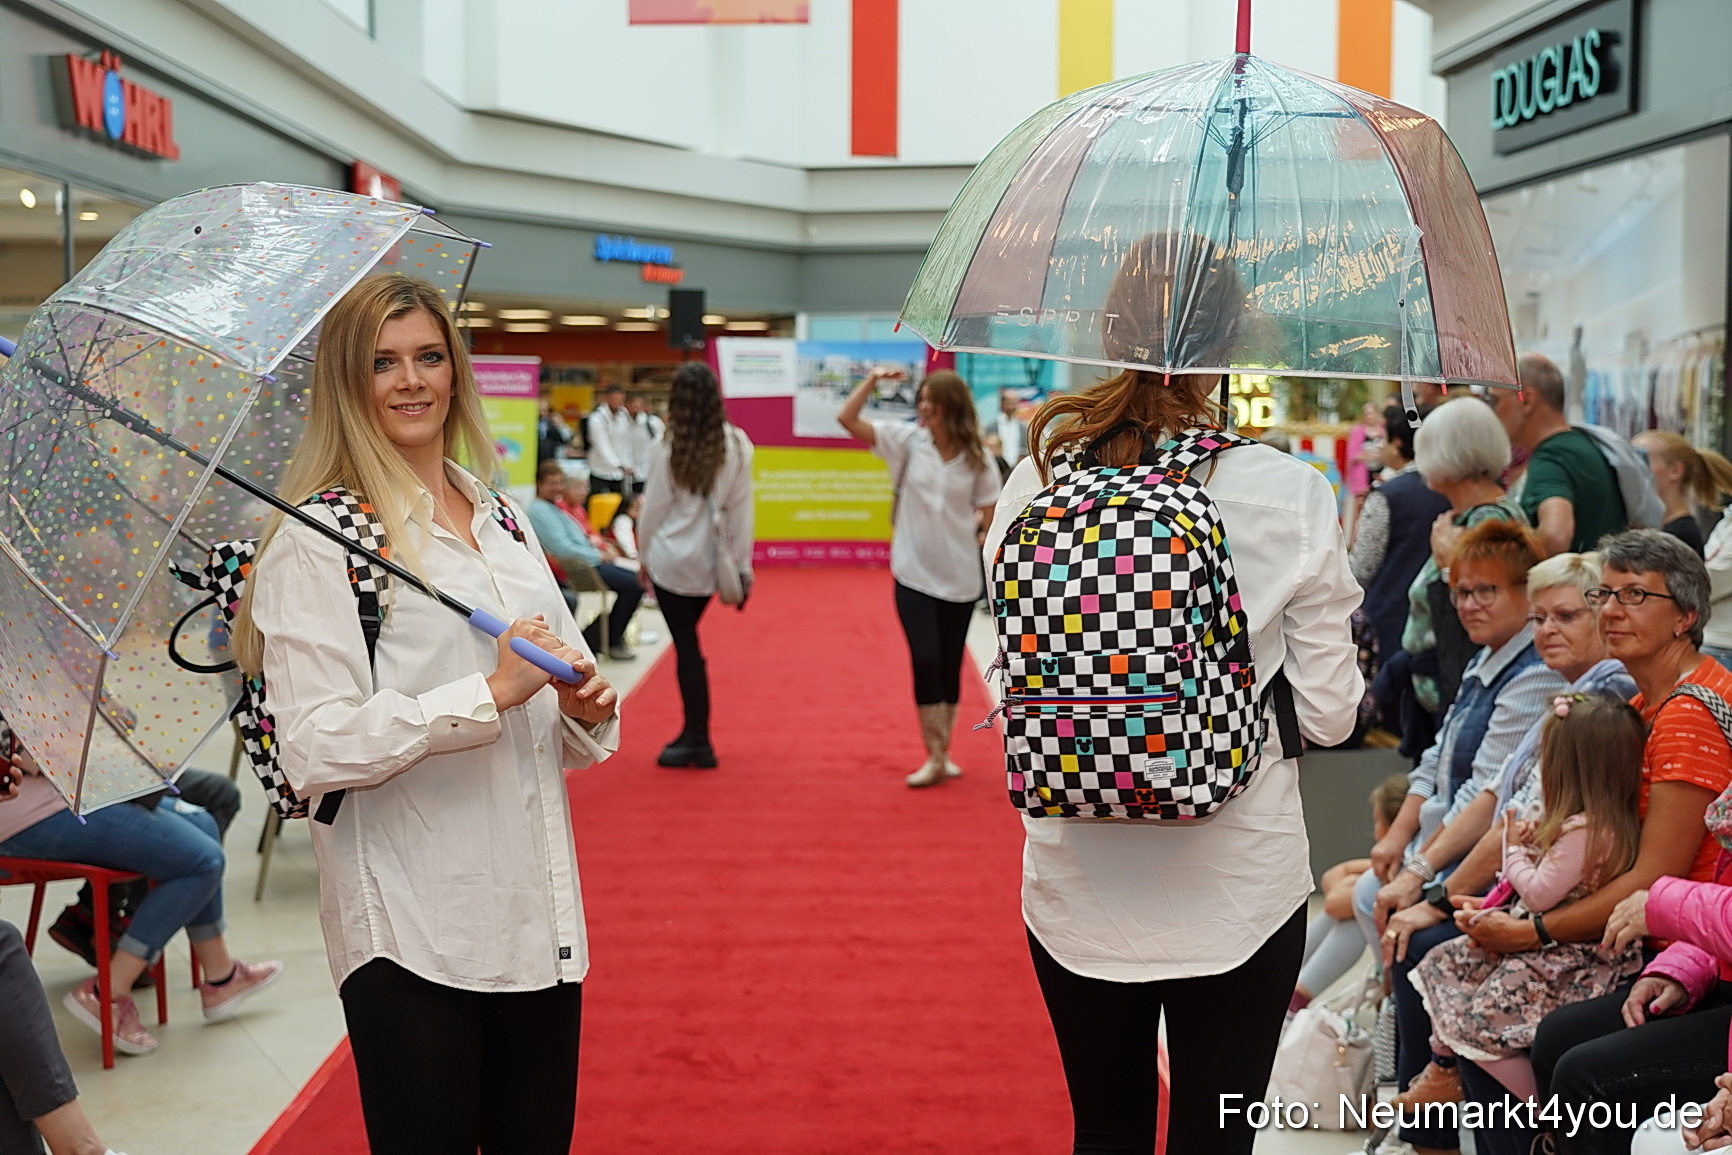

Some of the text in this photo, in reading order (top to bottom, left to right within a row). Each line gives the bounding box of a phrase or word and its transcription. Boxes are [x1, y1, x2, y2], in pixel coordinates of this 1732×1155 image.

[67, 50, 180, 161] WÖHRL
[1491, 28, 1601, 129] DOUGLAS
[994, 303, 1120, 334] ESPRIT
